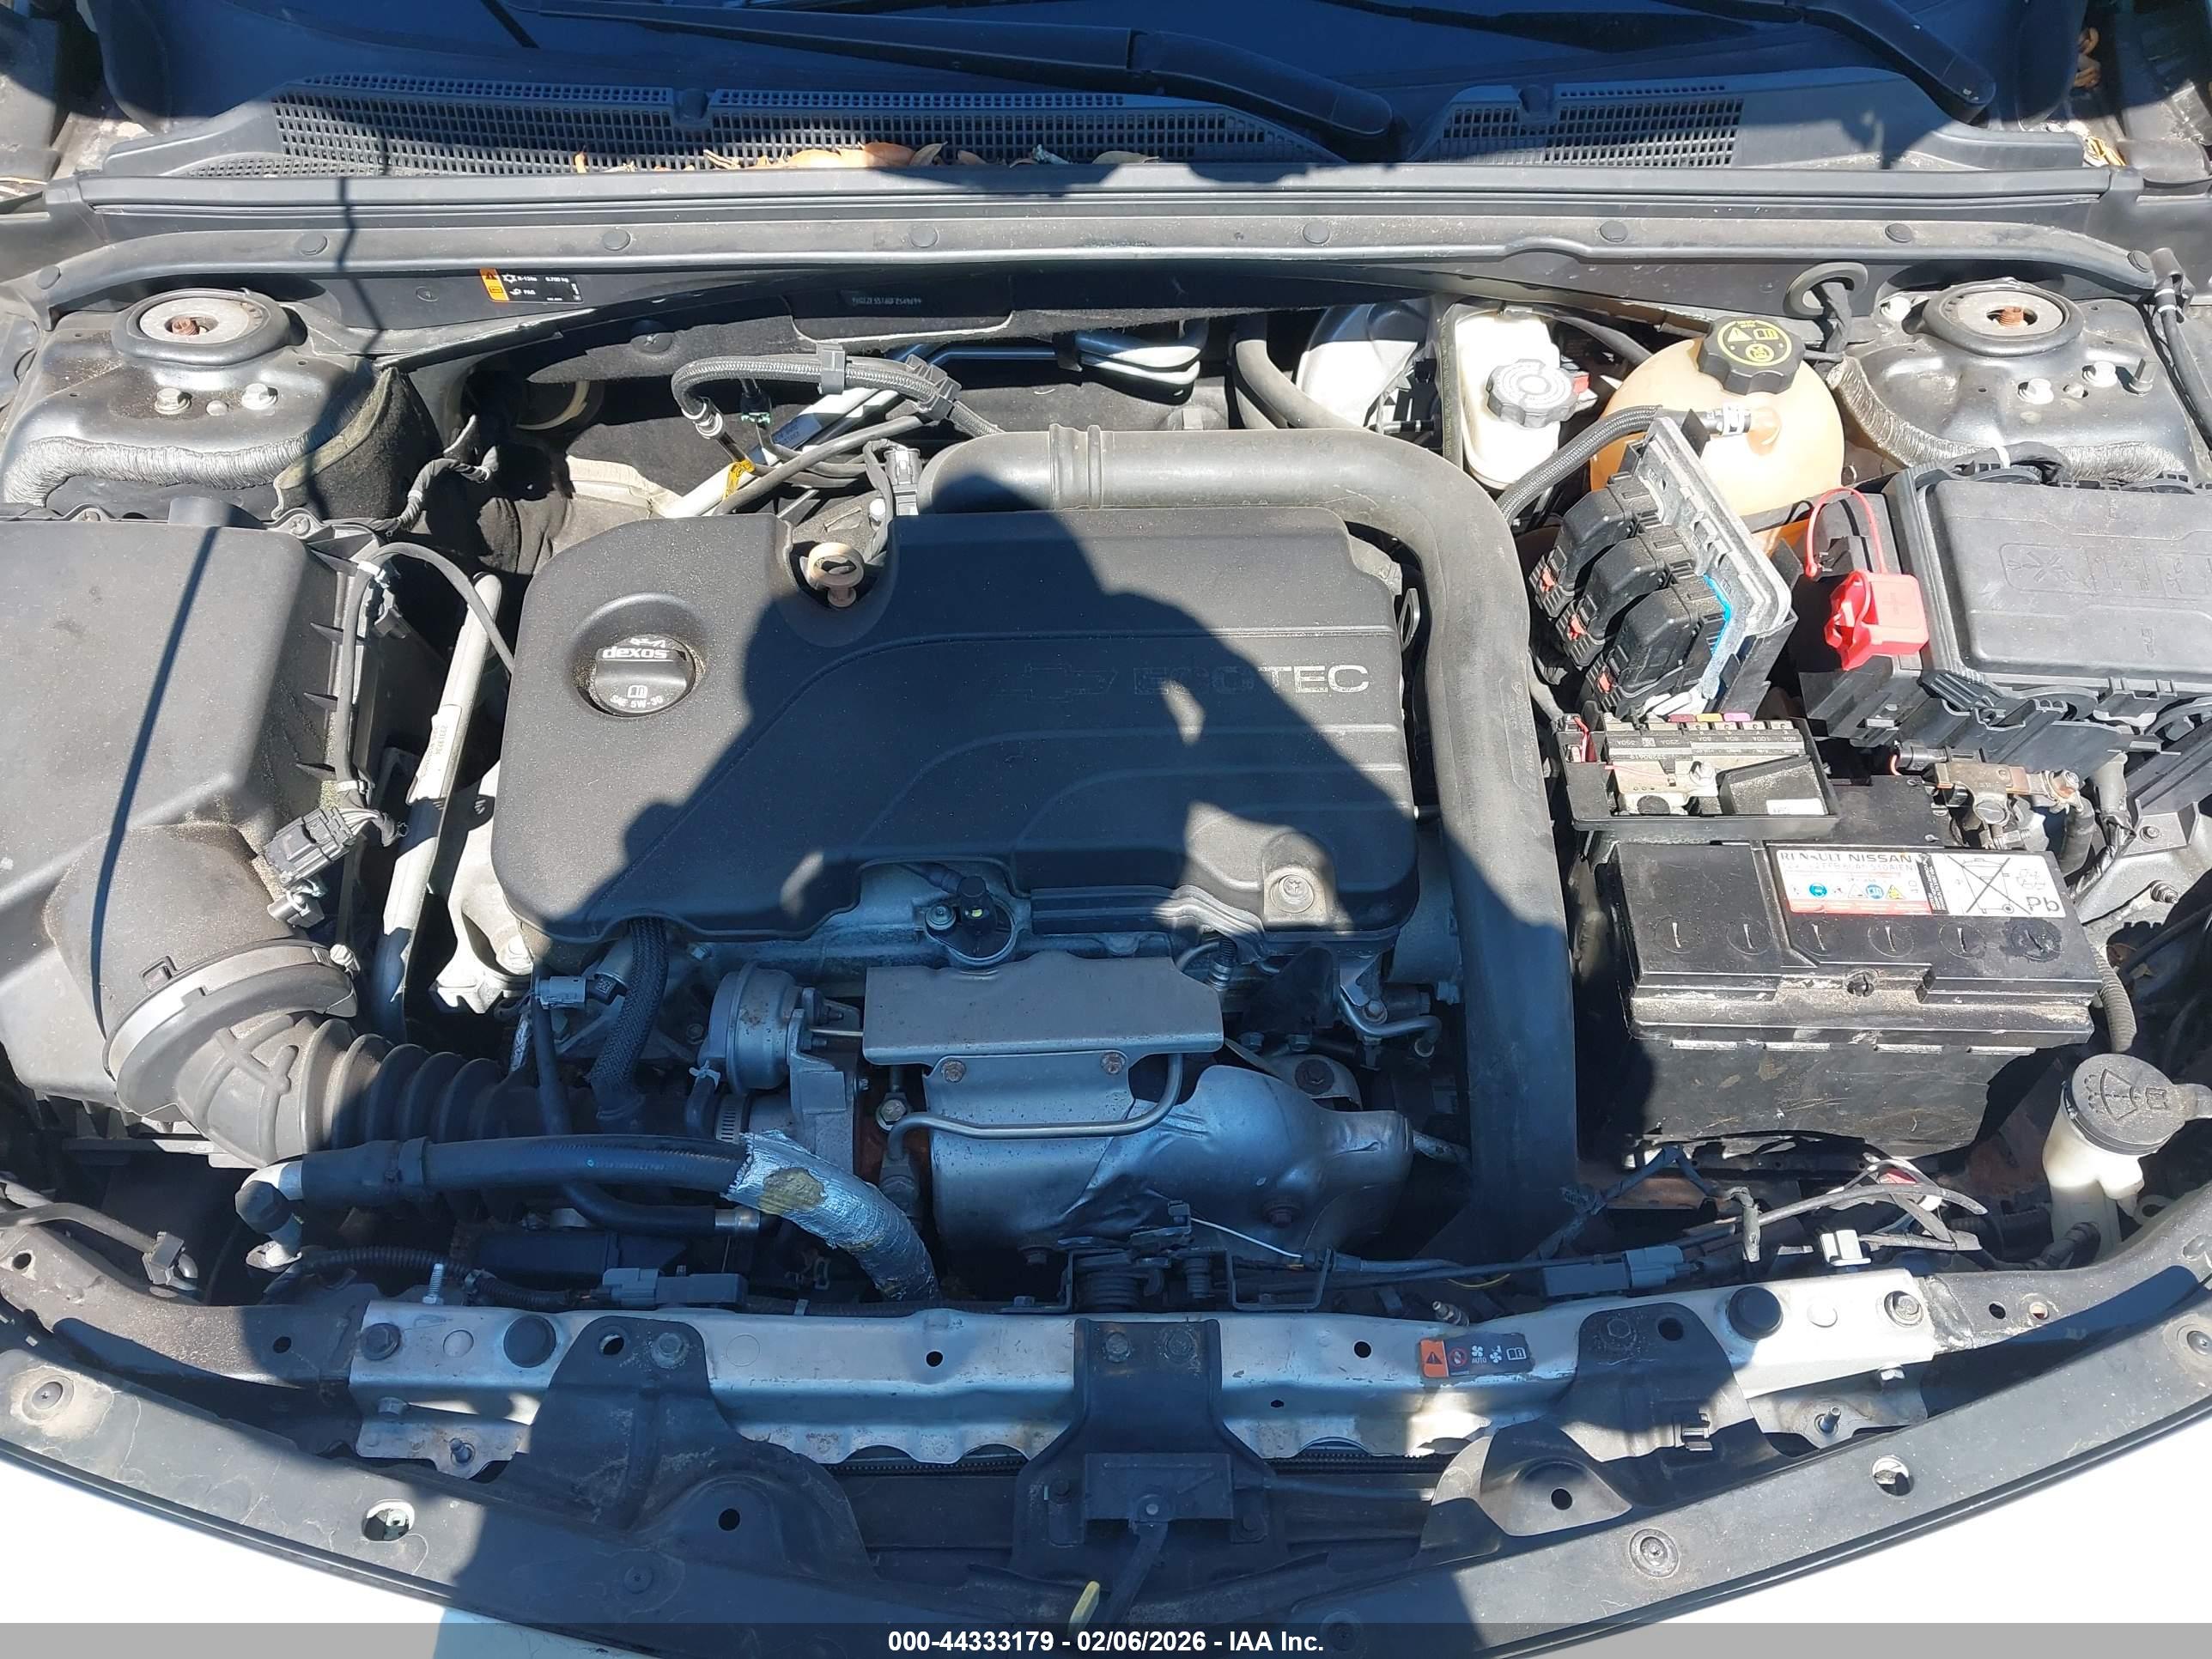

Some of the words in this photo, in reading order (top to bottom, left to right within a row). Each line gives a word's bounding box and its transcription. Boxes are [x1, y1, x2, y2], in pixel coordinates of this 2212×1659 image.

[602, 646, 670, 659] dexos
[1133, 665, 1370, 694] ECOTEC
[610, 695, 629, 706] SAE
[630, 696, 664, 708] 5W-30
[1848, 854, 1912, 863] NISSAN
[2026, 896, 2060, 912] Pb
